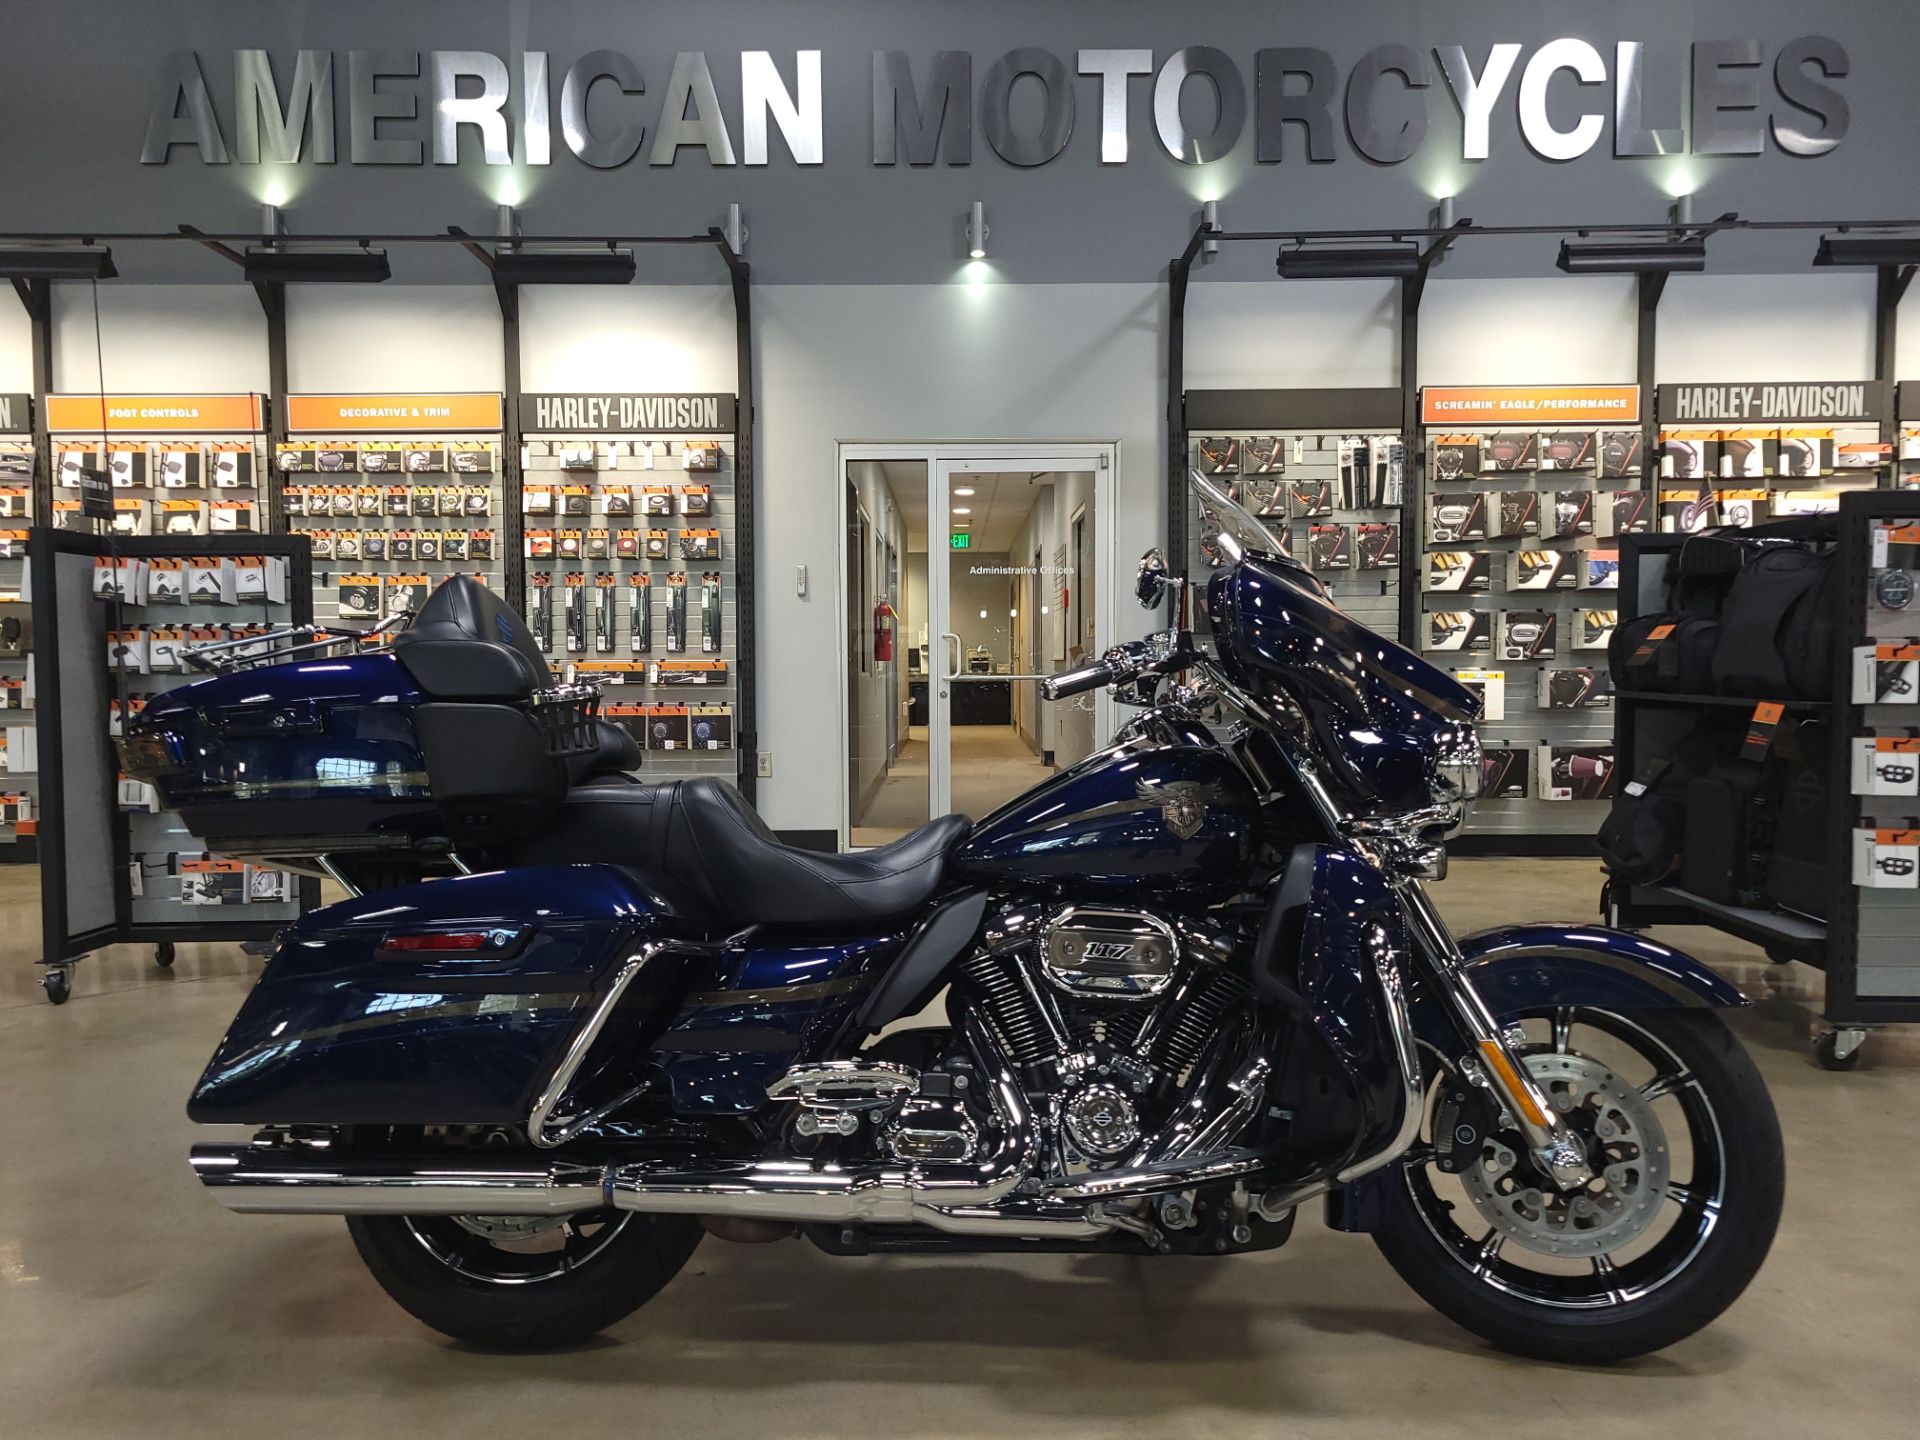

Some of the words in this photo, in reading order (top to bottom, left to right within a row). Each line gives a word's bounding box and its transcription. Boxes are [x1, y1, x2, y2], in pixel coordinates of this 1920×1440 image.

[139, 48, 824, 169] AMERICAN
[871, 35, 1851, 168] MOTORCYCLES
[1434, 400, 1496, 411] SCREAMIN'
[1676, 385, 1865, 419] HARLEY-DAVIDSON
[109, 408, 137, 418] FOOT
[140, 408, 199, 418] CONTROLS
[339, 407, 407, 417] DECORATIVE
[411, 408, 420, 417] &
[423, 407, 450, 417] TRIM
[536, 397, 719, 429] HARLEY-DAVIDSON
[953, 534, 969, 548] EXIT
[969, 565, 1038, 575] Administrative
[1039, 565, 1075, 575] Offices
[1083, 942, 1134, 959] 117
